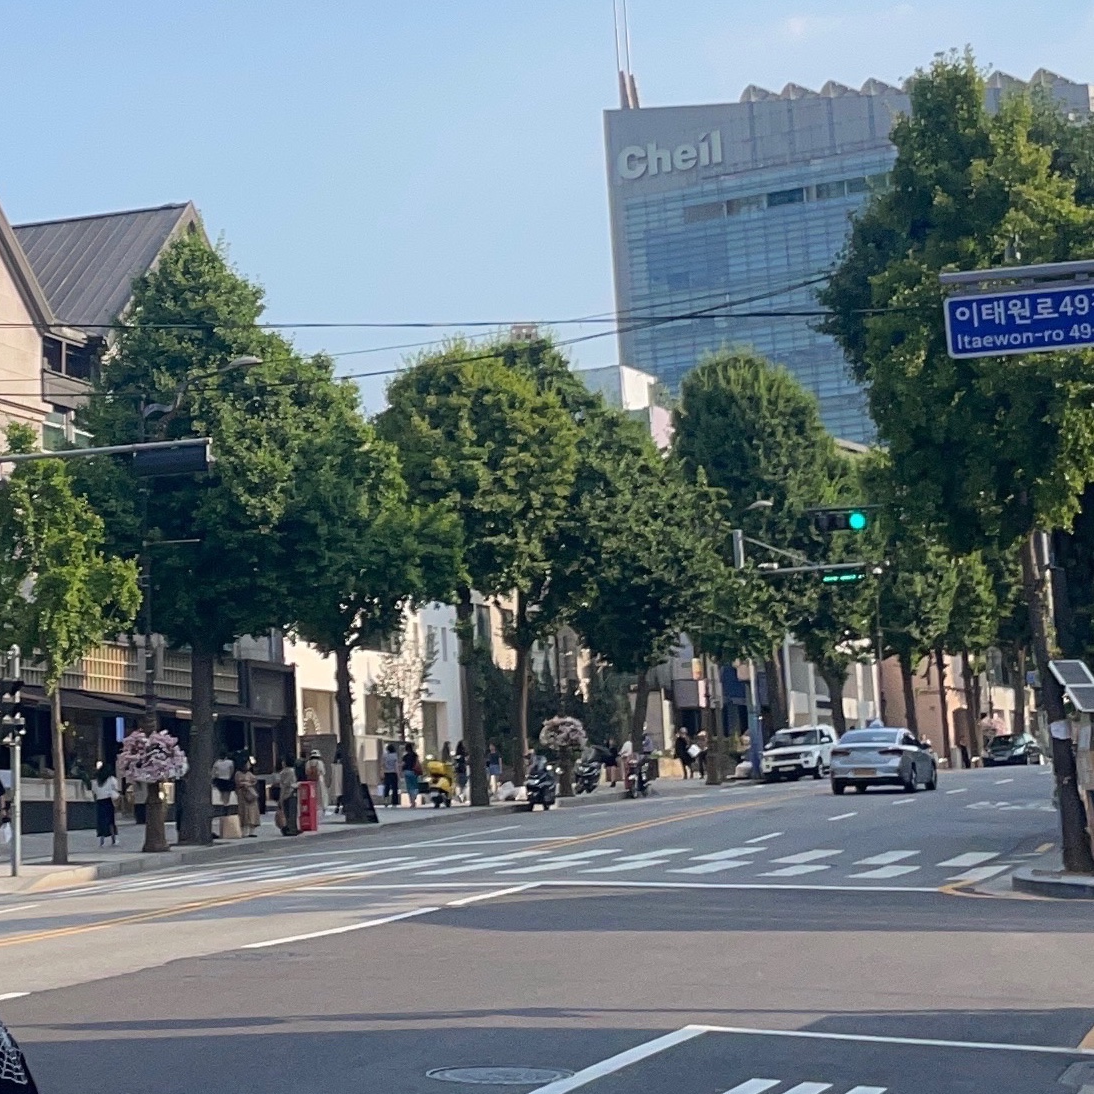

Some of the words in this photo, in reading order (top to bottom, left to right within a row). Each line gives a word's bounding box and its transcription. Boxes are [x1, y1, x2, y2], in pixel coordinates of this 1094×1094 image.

[617, 129, 722, 180] Cheil
[955, 294, 1094, 328] 이태원로49
[957, 329, 1064, 350] Itaewon-ro
